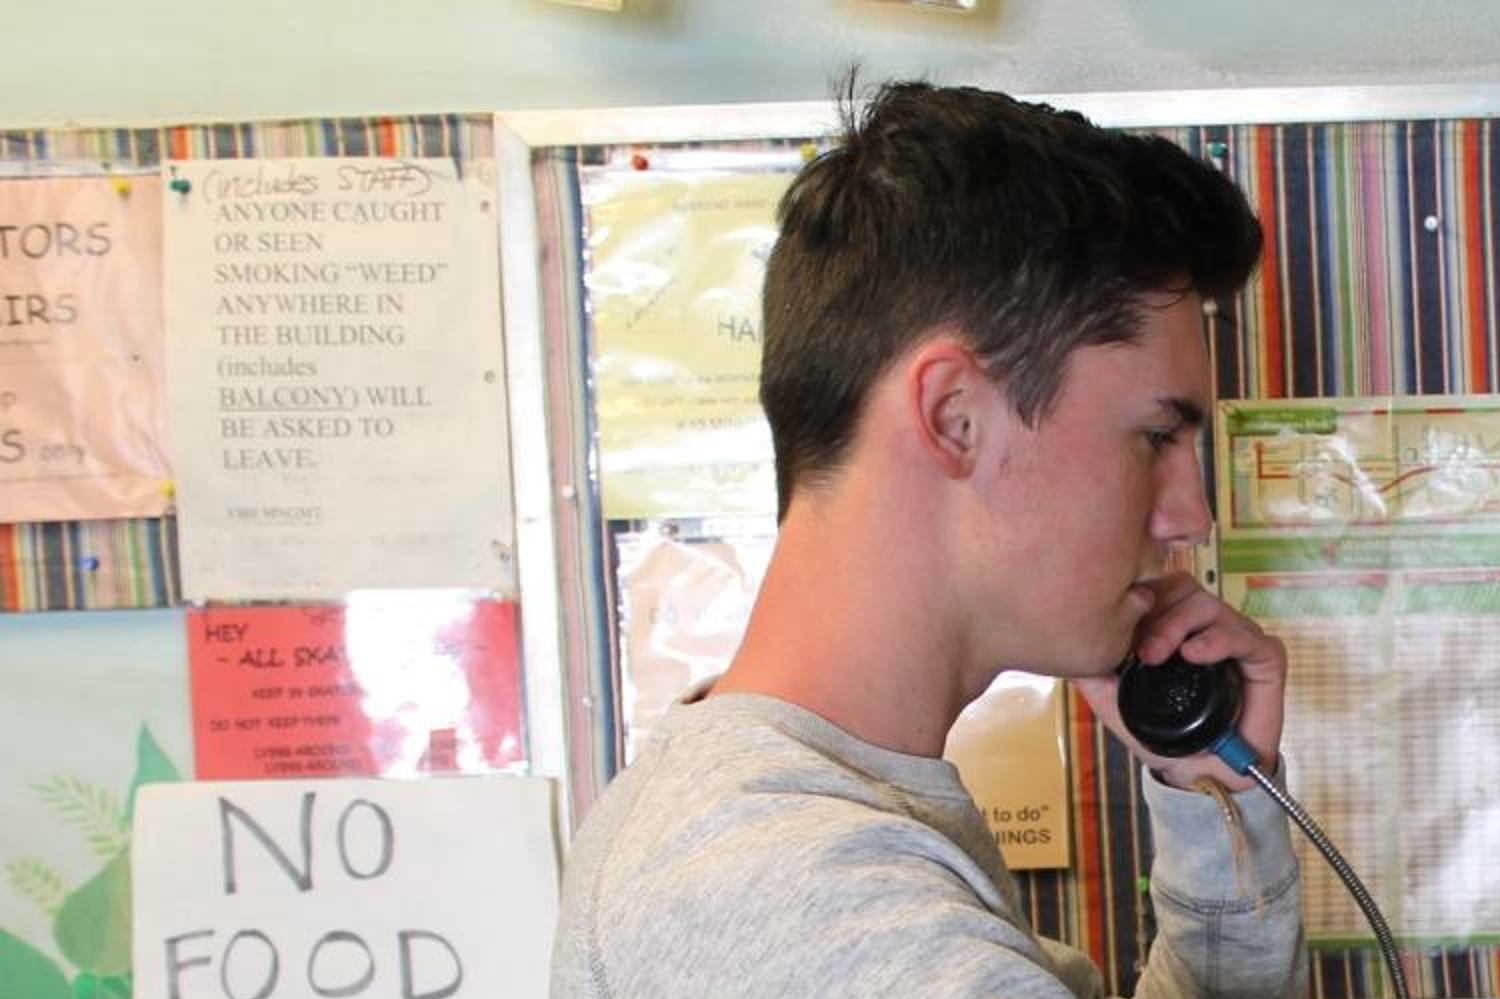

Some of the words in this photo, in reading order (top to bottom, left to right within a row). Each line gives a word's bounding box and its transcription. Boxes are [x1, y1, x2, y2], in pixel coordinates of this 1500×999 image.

[215, 201, 326, 223] ANYONE
[333, 201, 447, 224] CAUGHT
[214, 231, 250, 252] OR
[257, 231, 324, 252] SEEN
[214, 262, 338, 285] SMOKING
[216, 294, 369, 315] ANYWHERE
[377, 293, 405, 314] IN
[219, 324, 269, 346] THE
[275, 324, 405, 347] BUILDING
[216, 356, 318, 380] (includes
[218, 385, 359, 409] BALCONY)
[366, 385, 432, 408] WILL
[221, 417, 255, 439] BE
[263, 417, 352, 439] ASKED
[358, 416, 395, 438] TO
[205, 623, 249, 643] HEY
[239, 648, 285, 668] ALL
[993, 806, 1012, 822] to
[217, 791, 395, 895] NO
